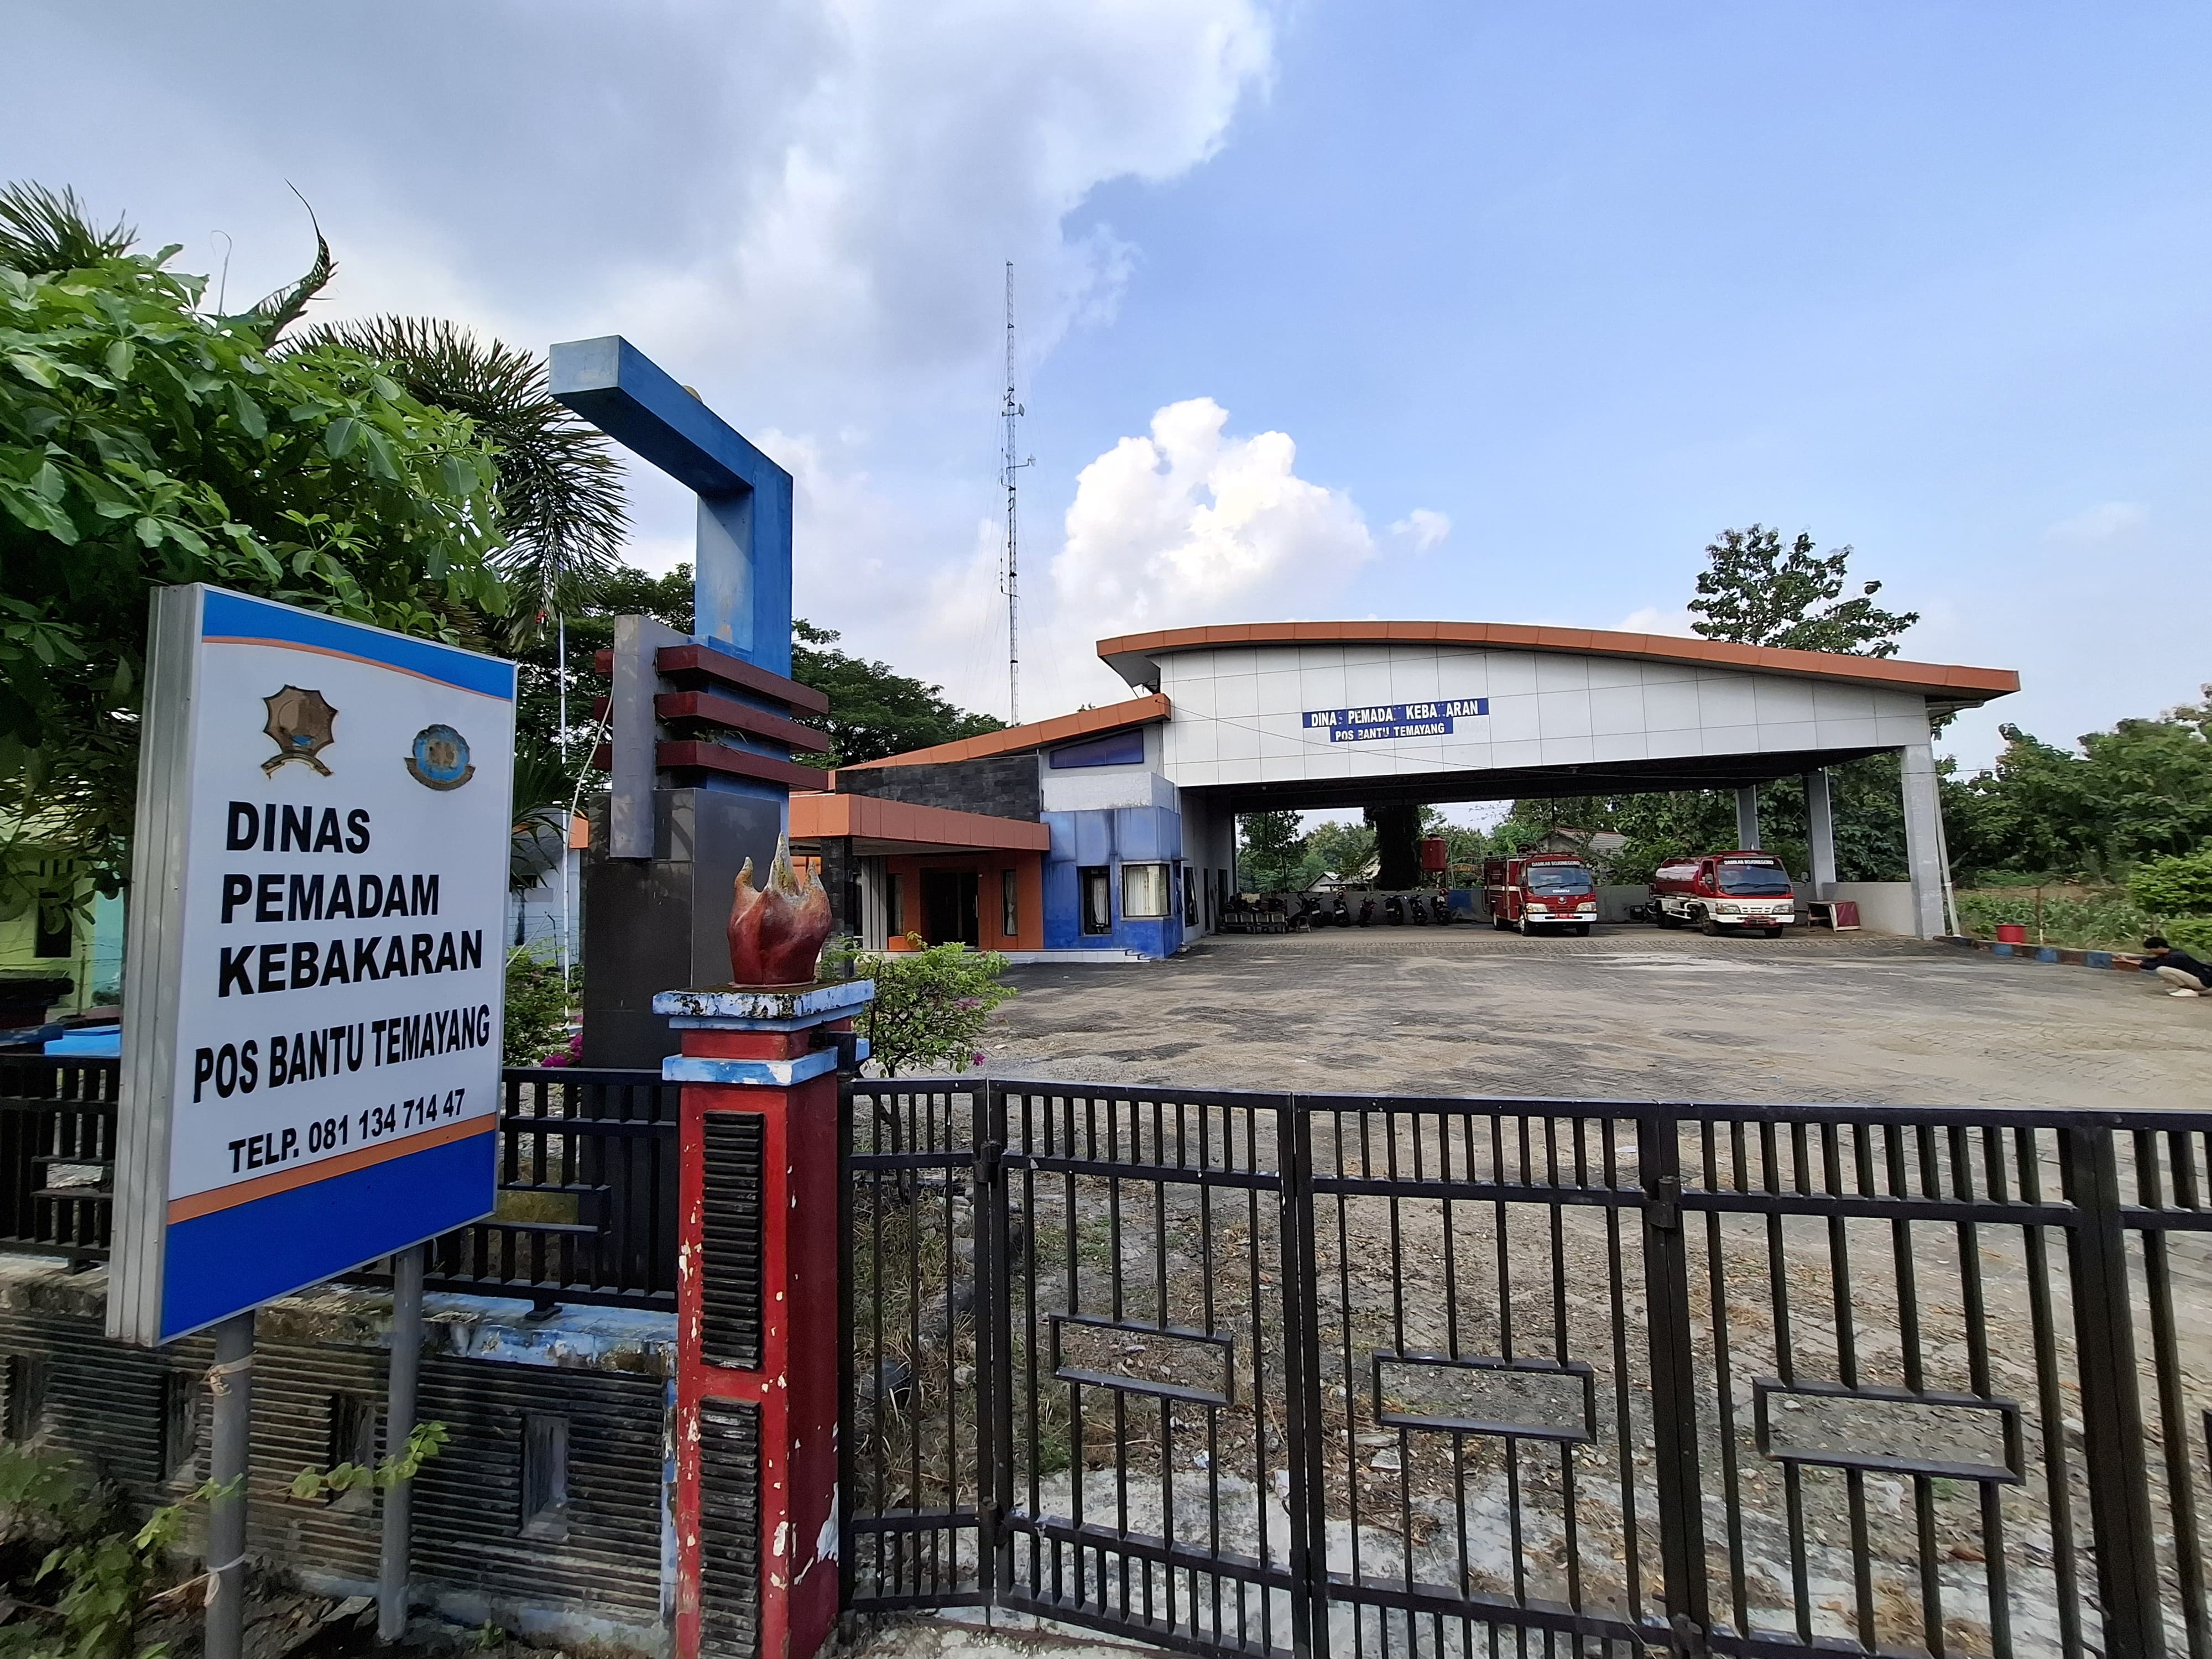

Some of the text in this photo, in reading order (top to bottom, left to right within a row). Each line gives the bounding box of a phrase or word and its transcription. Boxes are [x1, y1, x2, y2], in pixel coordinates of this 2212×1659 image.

[1335, 730, 1354, 741] POS
[1358, 727, 1389, 740] BANTU
[1394, 722, 1445, 737] TEMAYANG
[1348, 707, 1401, 724] PEMADA
[1406, 700, 1478, 719] KEBAARAN
[226, 801, 370, 854] DINAS
[220, 874, 440, 924] PEMADAM
[217, 929, 483, 998] KEBAKARAN
[193, 1004, 491, 1104] POS BANTU TEMAYANG
[228, 1088, 466, 1173] TELP. 081 134 714 47
